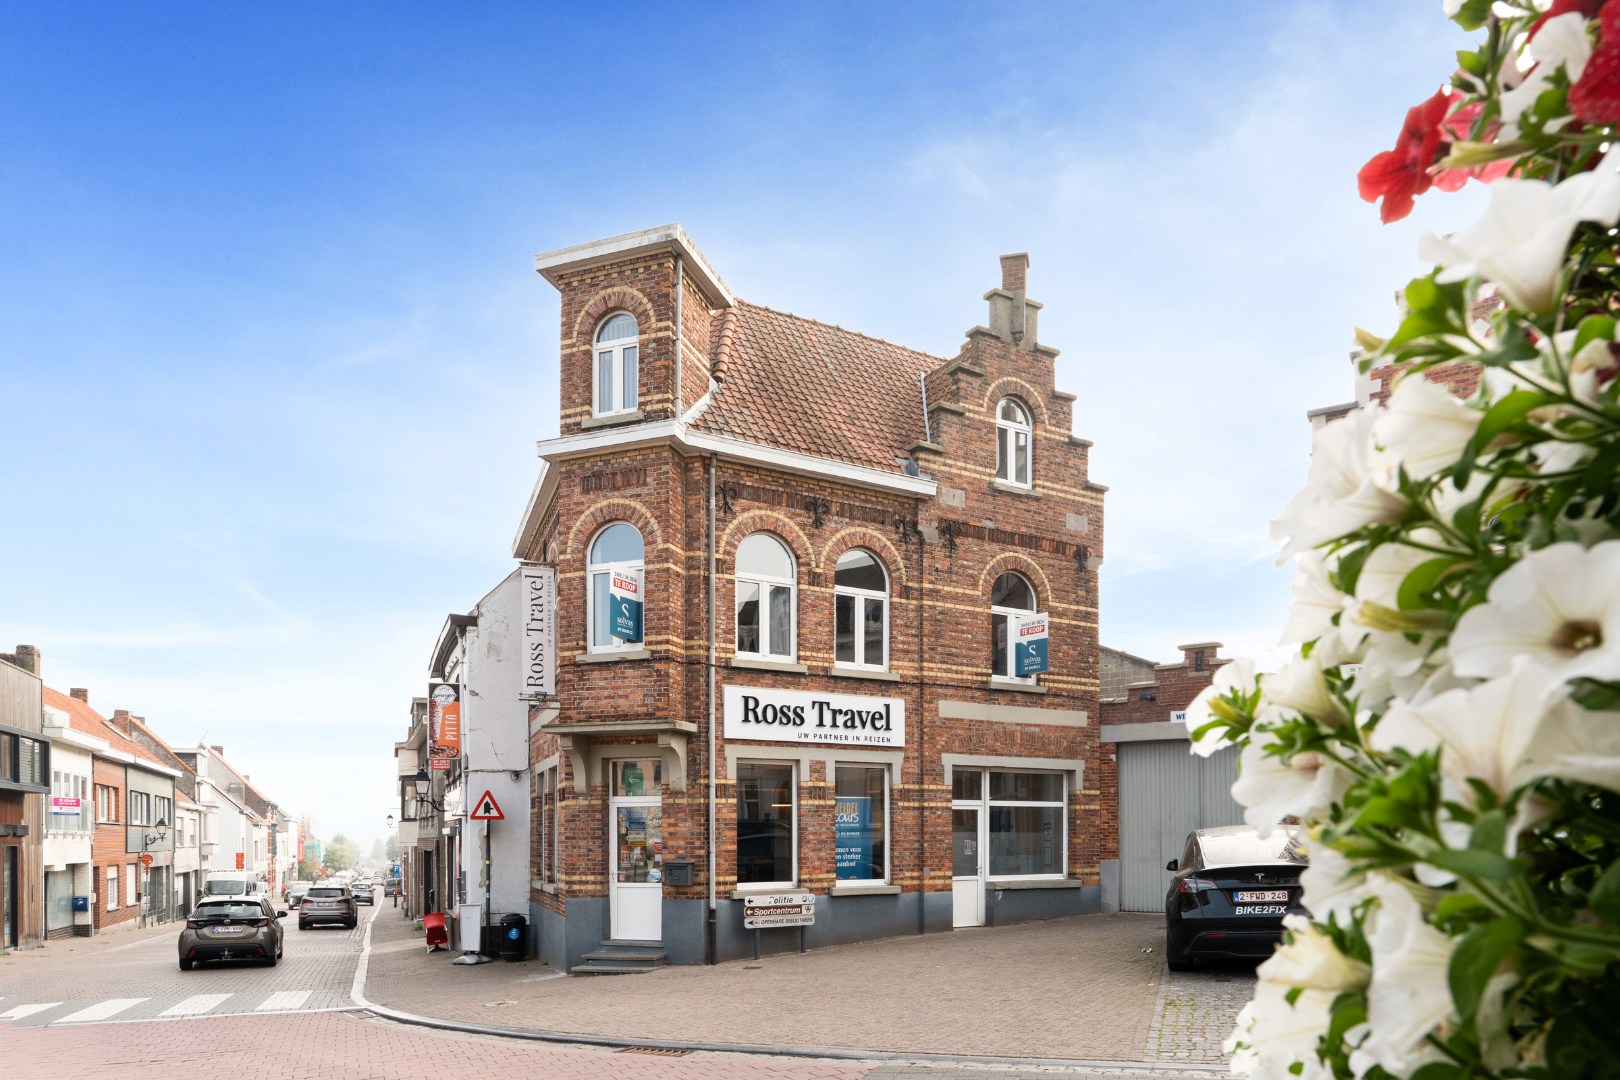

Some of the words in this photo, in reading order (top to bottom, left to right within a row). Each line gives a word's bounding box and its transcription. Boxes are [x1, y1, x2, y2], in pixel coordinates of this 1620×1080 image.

[614, 578, 622, 588] TE
[622, 581, 637, 592] KOOP
[524, 574, 544, 637] Travel
[1028, 626, 1044, 635] KOOP
[527, 642, 544, 687] Ross
[741, 695, 805, 726] Ross
[811, 700, 892, 731] Travel
[446, 714, 458, 740] PITTA
[813, 733, 849, 741] PARTNER
[864, 735, 892, 743] REIZEN
[754, 907, 800, 916] Sportcentrum
[1236, 906, 1287, 914] BIKE2FIX
